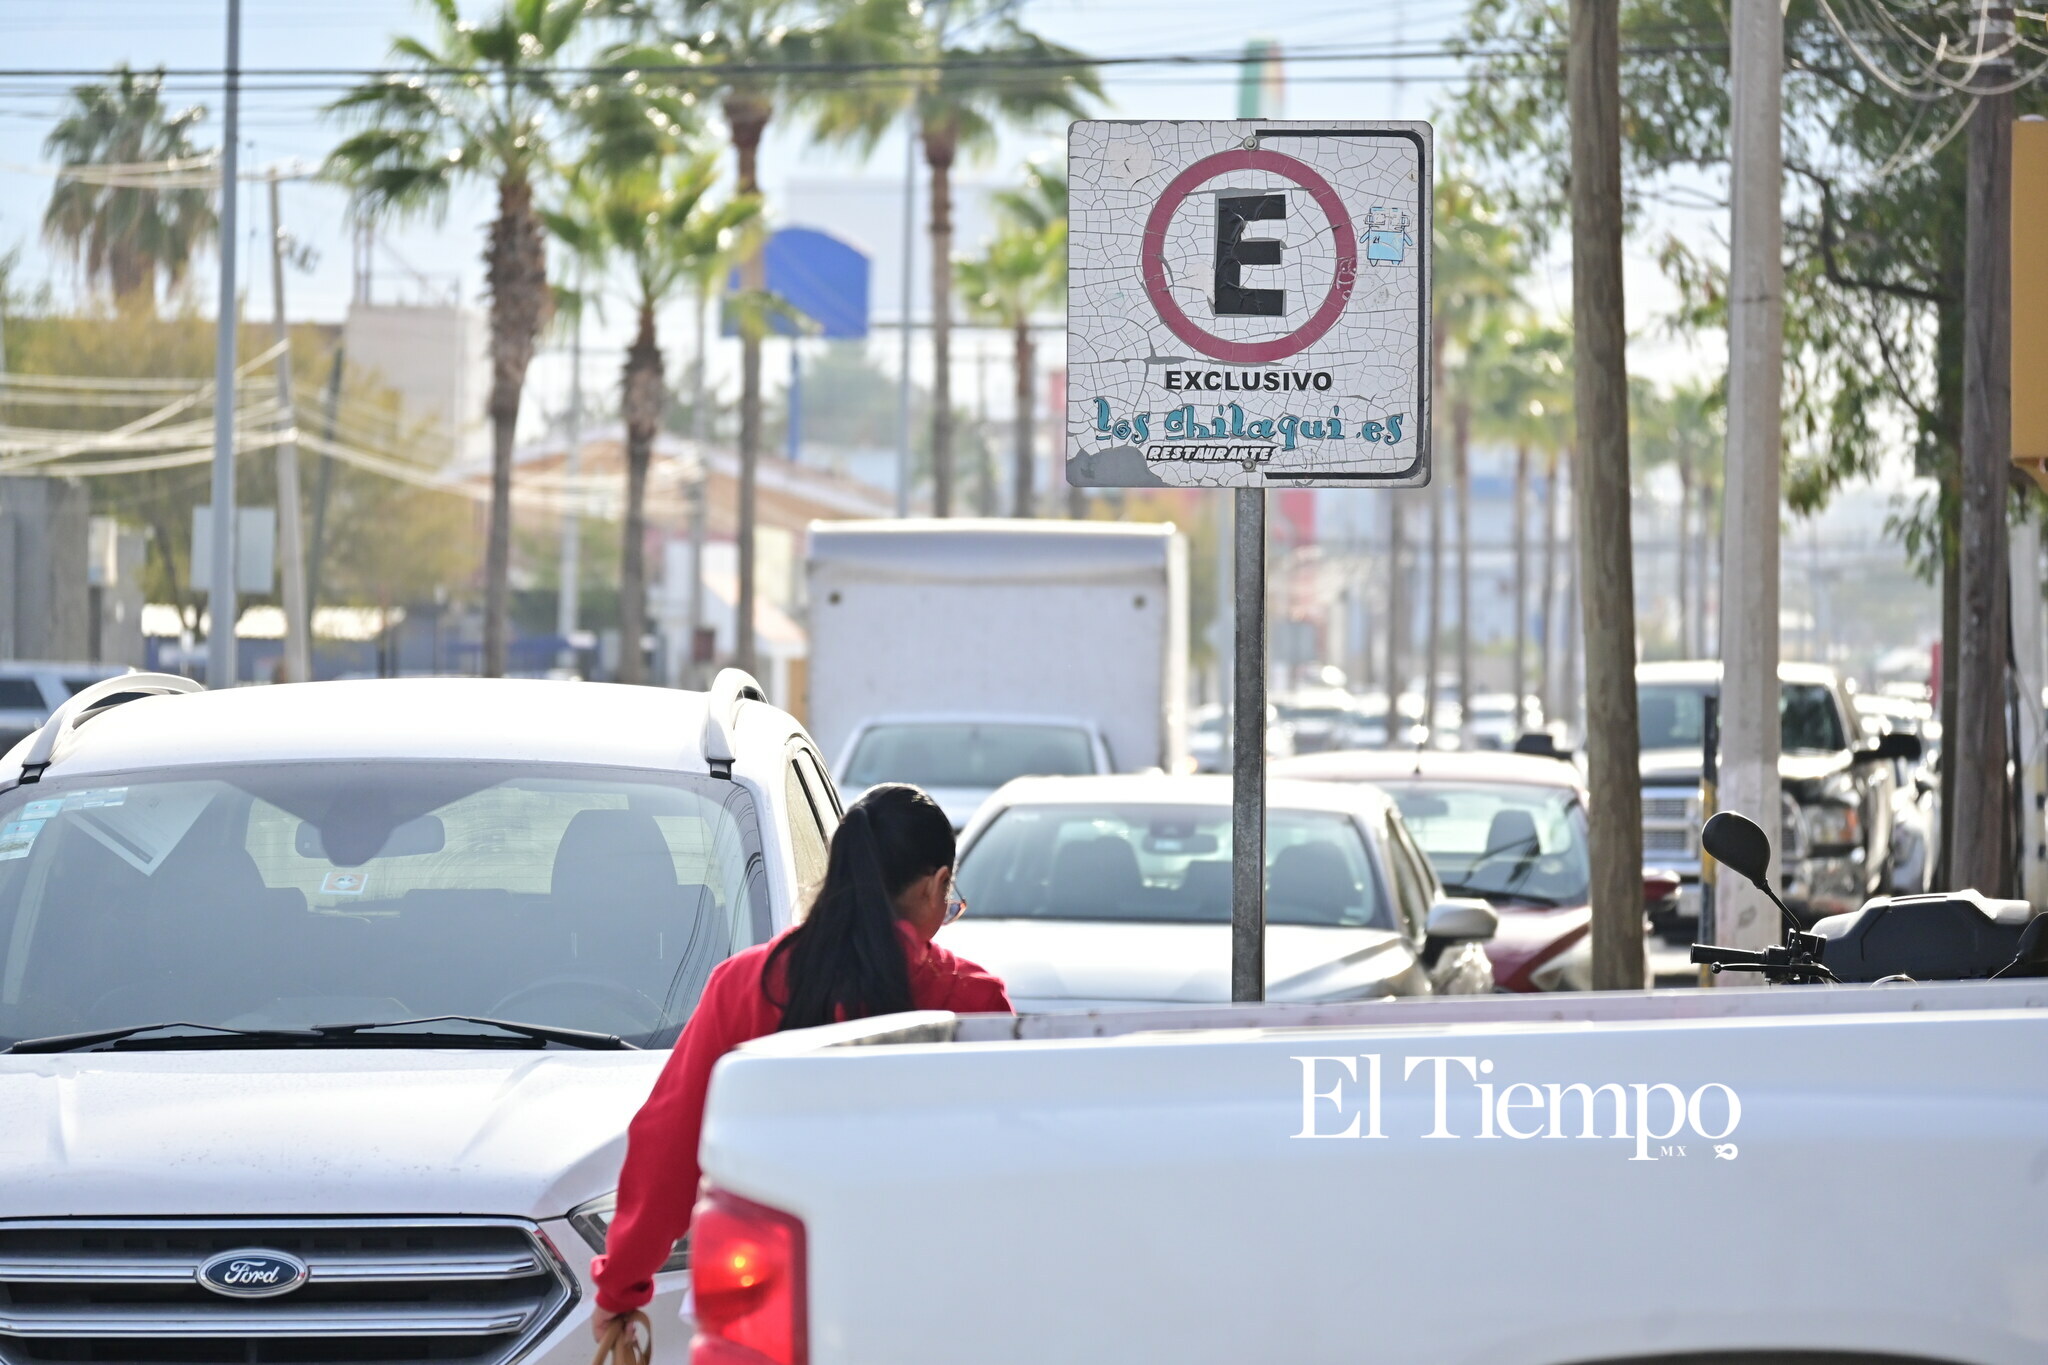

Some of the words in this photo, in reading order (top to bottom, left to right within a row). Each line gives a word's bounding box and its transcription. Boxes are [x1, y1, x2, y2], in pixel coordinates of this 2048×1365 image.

[1214, 194, 1286, 316] E
[1165, 371, 1332, 391] EXCLUSIVO
[1147, 446, 1273, 462] RESTAURANTE
[224, 1260, 280, 1283] Ford
